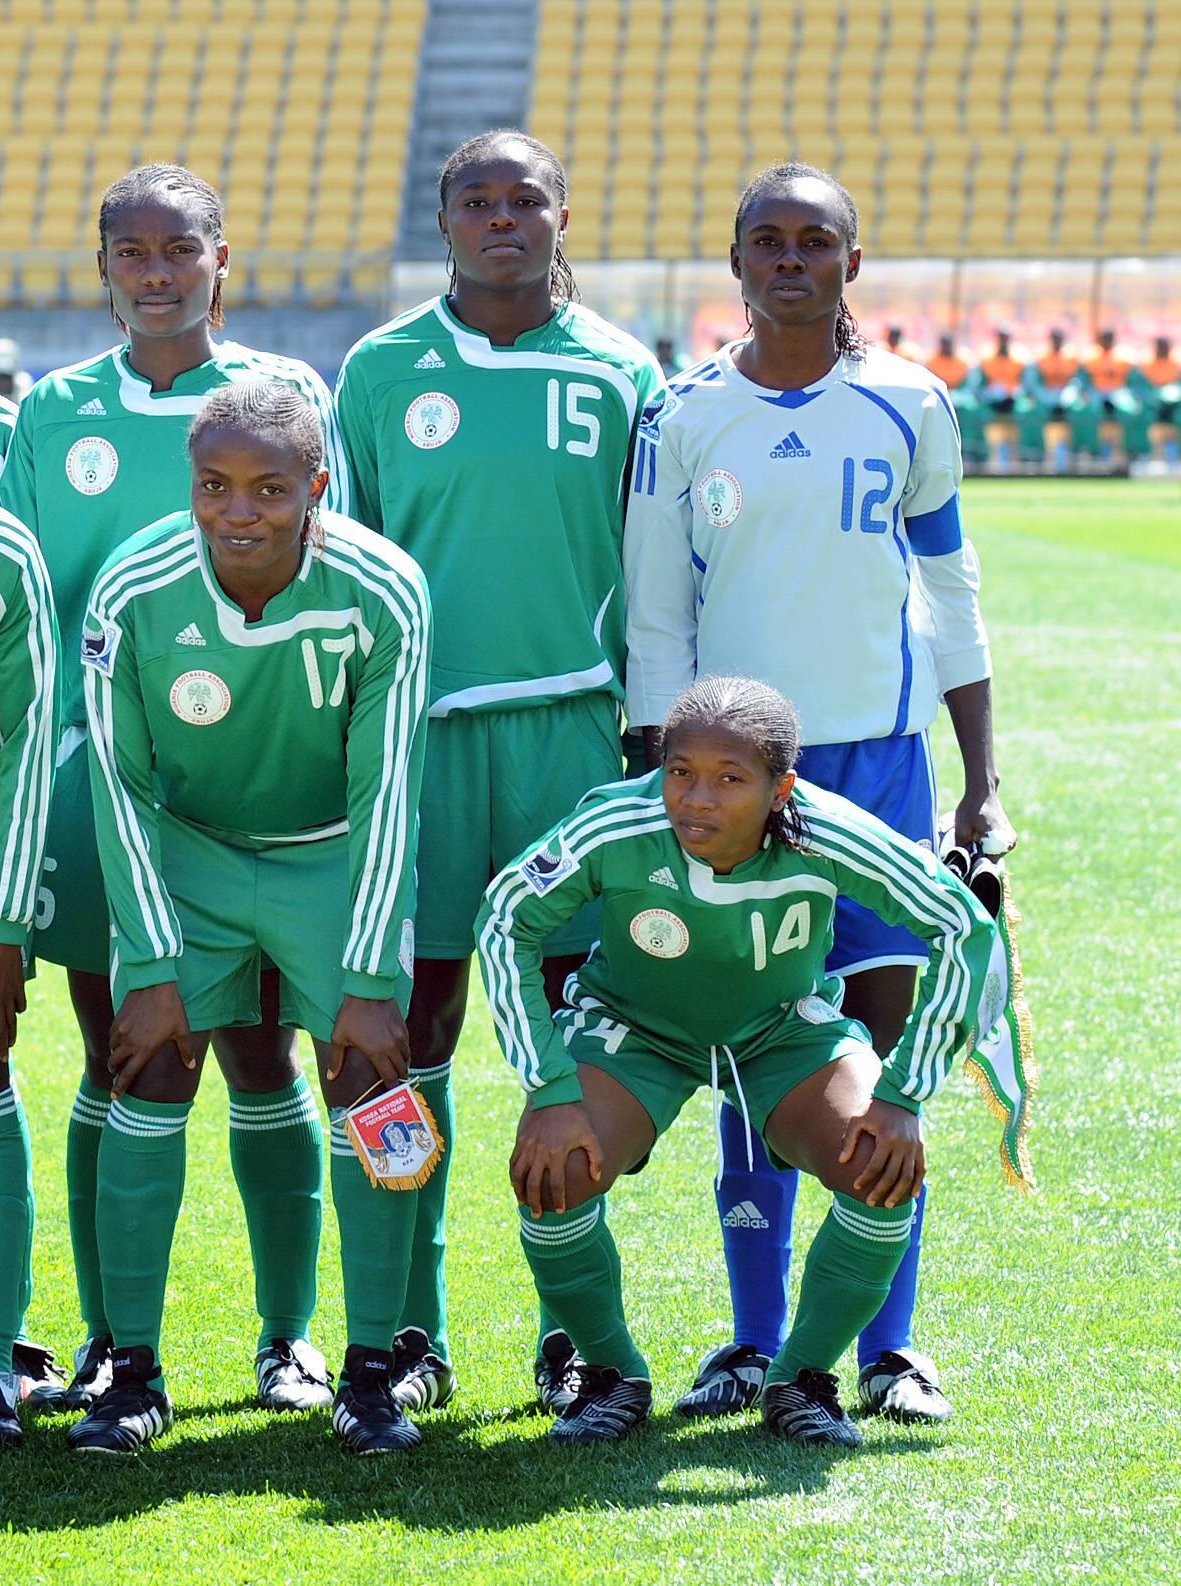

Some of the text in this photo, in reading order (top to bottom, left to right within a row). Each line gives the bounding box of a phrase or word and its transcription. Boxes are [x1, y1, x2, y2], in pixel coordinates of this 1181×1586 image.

[413, 360, 446, 369] adidas
[77, 408, 107, 416] adidas
[547, 379, 602, 458] 15
[770, 448, 811, 459] adidas
[841, 457, 894, 533] 12
[175, 636, 207, 646] adidas
[301, 633, 356, 709] 17
[648, 875, 679, 891] adidas
[750, 900, 811, 971] 14
[722, 1216, 769, 1229] adidas
